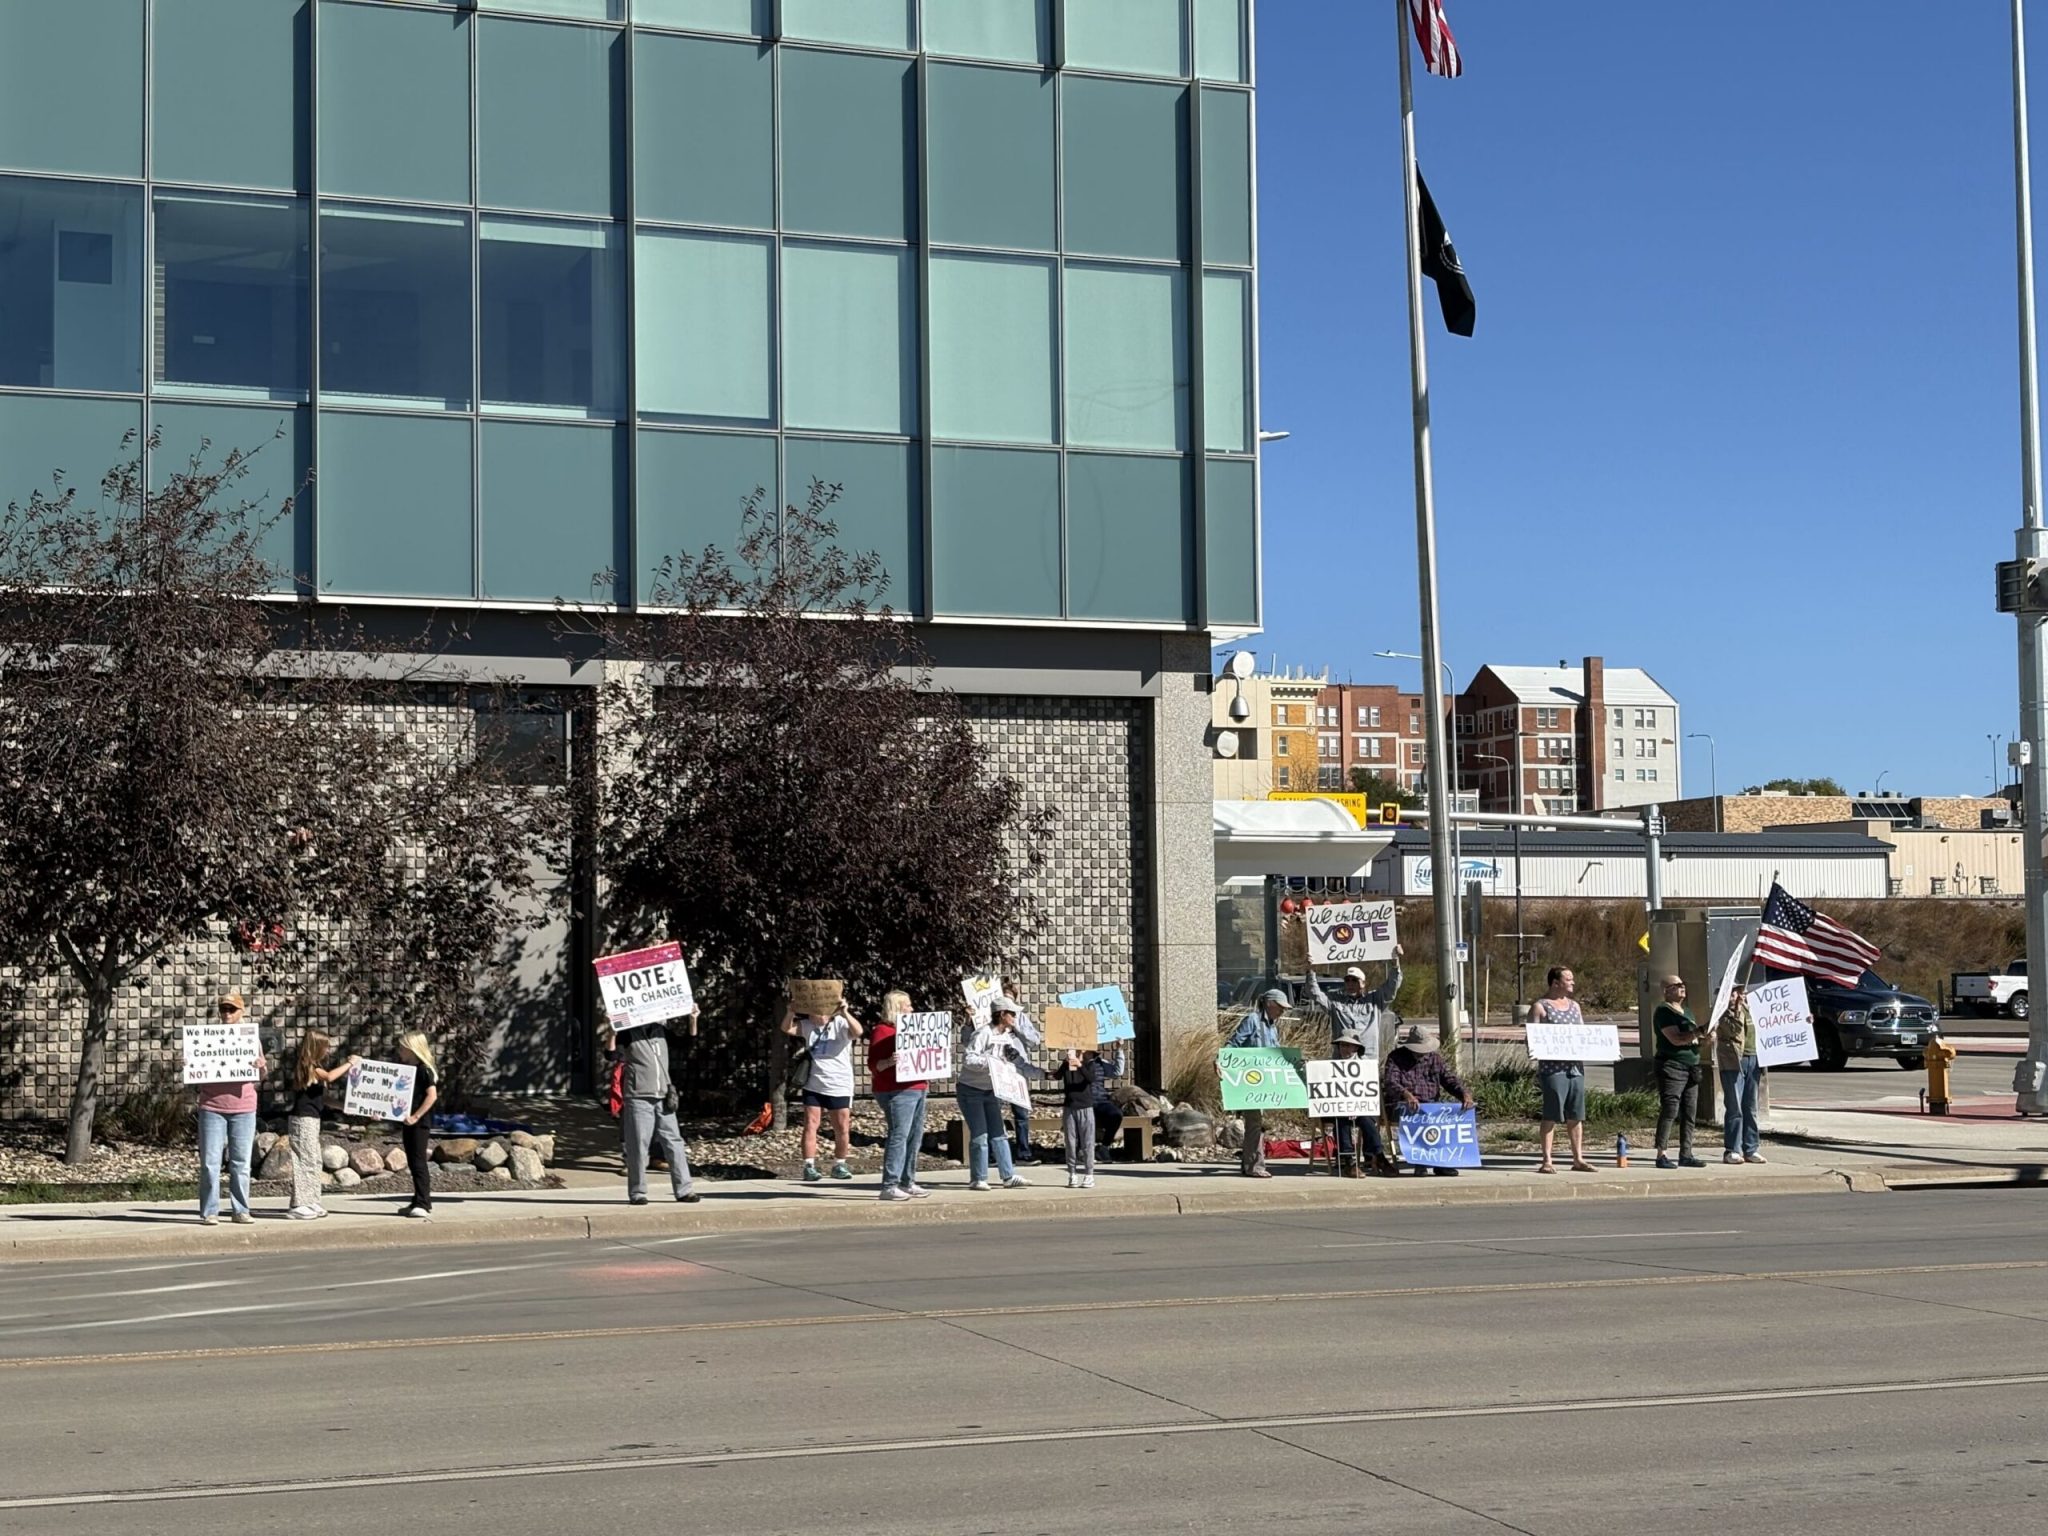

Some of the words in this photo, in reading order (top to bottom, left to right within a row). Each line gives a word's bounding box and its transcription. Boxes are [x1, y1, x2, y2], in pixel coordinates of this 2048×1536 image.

[1308, 907, 1332, 925] We
[1335, 910, 1350, 922] the
[1350, 904, 1392, 924] People
[1311, 921, 1390, 944] VOTE
[1327, 945, 1366, 961] Early
[613, 996, 635, 1009] FOR
[641, 984, 683, 1003] CHANGE
[973, 989, 999, 1009] VOTE
[1754, 984, 1791, 1004] VOTE
[1083, 998, 1113, 1016] OTE
[1770, 1001, 1793, 1014] FOR
[900, 1013, 926, 1032] SAVE
[928, 1011, 950, 1032] OUR
[1758, 1012, 1802, 1029] CHANGE
[204, 1028, 225, 1036] Have
[1552, 1036, 1572, 1044] NOT
[1760, 1035, 1783, 1050] VOTE
[1784, 1031, 1808, 1045] BLUE
[897, 1032, 949, 1050] DEMOCRACY
[910, 1048, 947, 1074] VOTE!
[1220, 1052, 1247, 1068] Yes
[1253, 1056, 1271, 1066] we
[189, 1071, 208, 1079] NOT
[216, 1070, 222, 1078] A
[230, 1069, 257, 1077] KING!
[361, 1064, 399, 1077] Marching
[1222, 1068, 1302, 1087] VOTE
[1330, 1061, 1360, 1078] NO
[362, 1076, 375, 1084] For
[382, 1078, 393, 1089] My
[1308, 1080, 1378, 1099] KINGS
[359, 1106, 387, 1117] Future
[1313, 1102, 1346, 1113] VOTE
[1346, 1101, 1378, 1112] EARLY
[1403, 1124, 1474, 1146] VOTE
[1411, 1146, 1465, 1162] EARLY!
